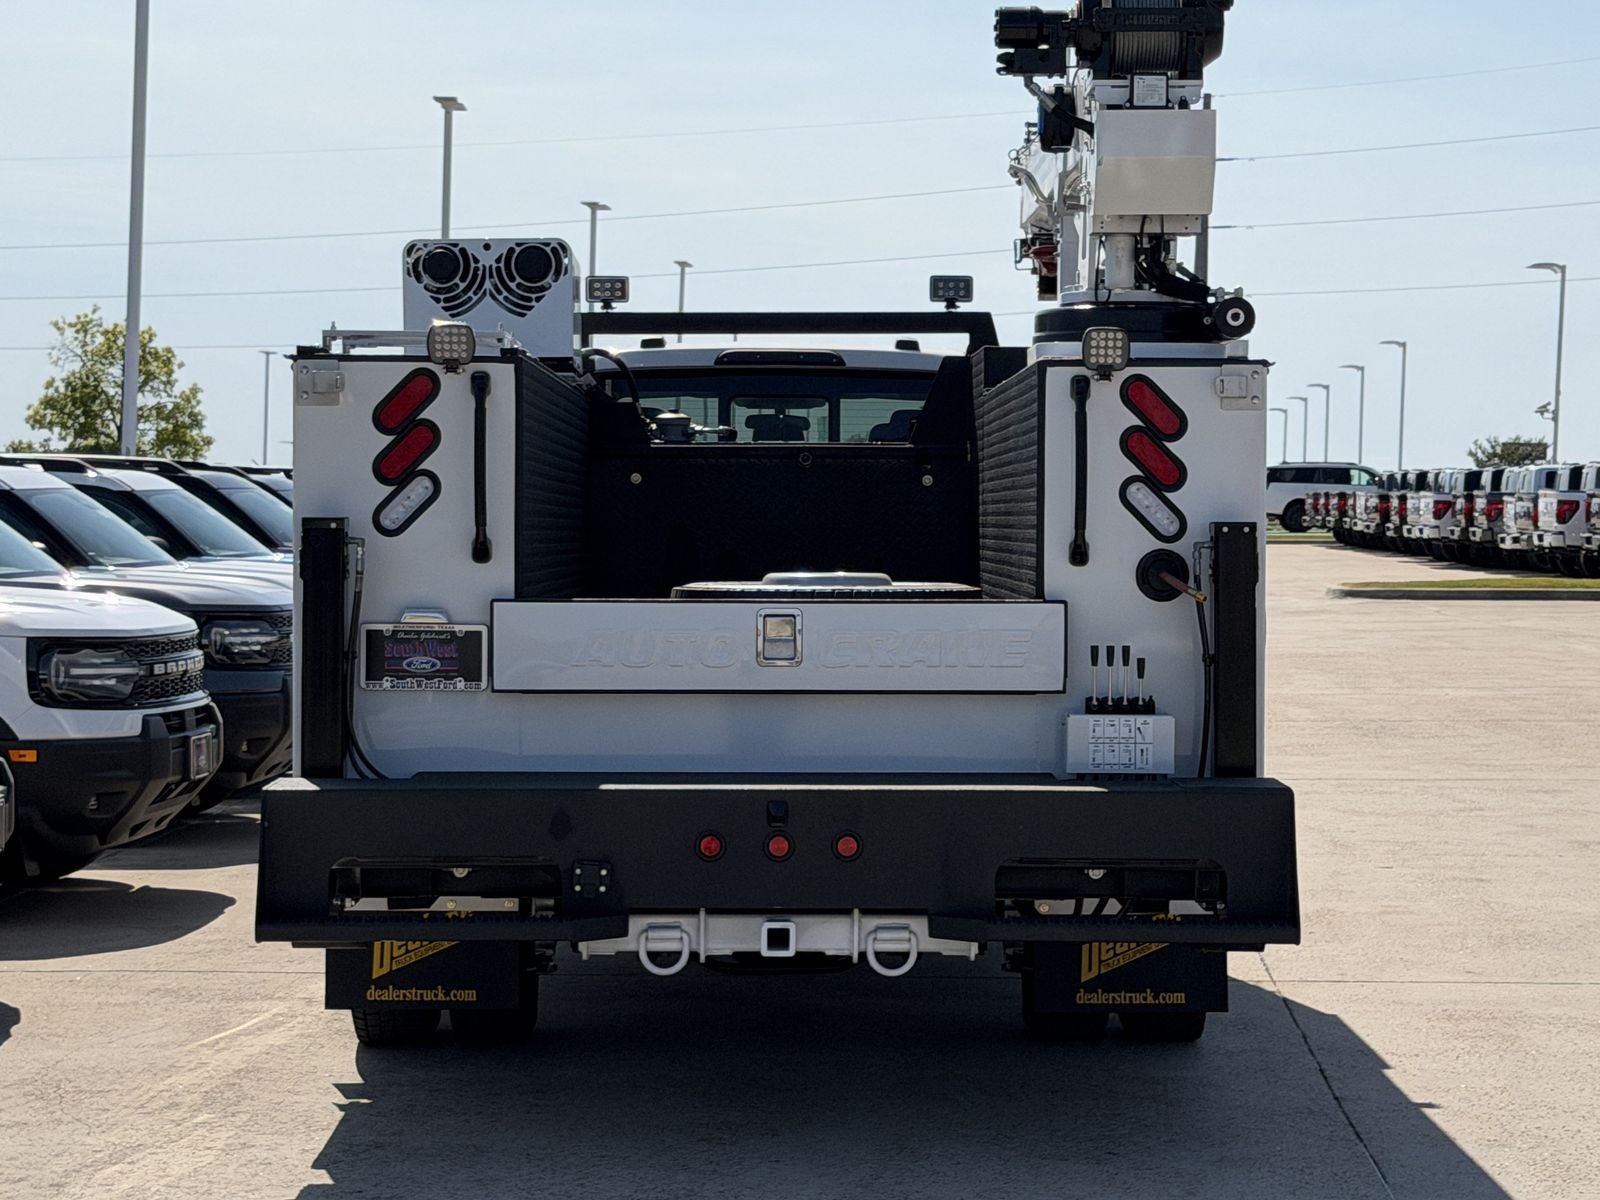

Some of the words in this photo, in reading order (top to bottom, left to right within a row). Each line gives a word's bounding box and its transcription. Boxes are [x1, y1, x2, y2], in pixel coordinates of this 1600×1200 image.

[571, 628, 742, 669] AUTO
[820, 628, 1035, 669] CRANE
[410, 659, 433, 670] Ford
[366, 985, 477, 1001] dealerstruck.com
[1075, 988, 1186, 1004] dealerstruck.com
